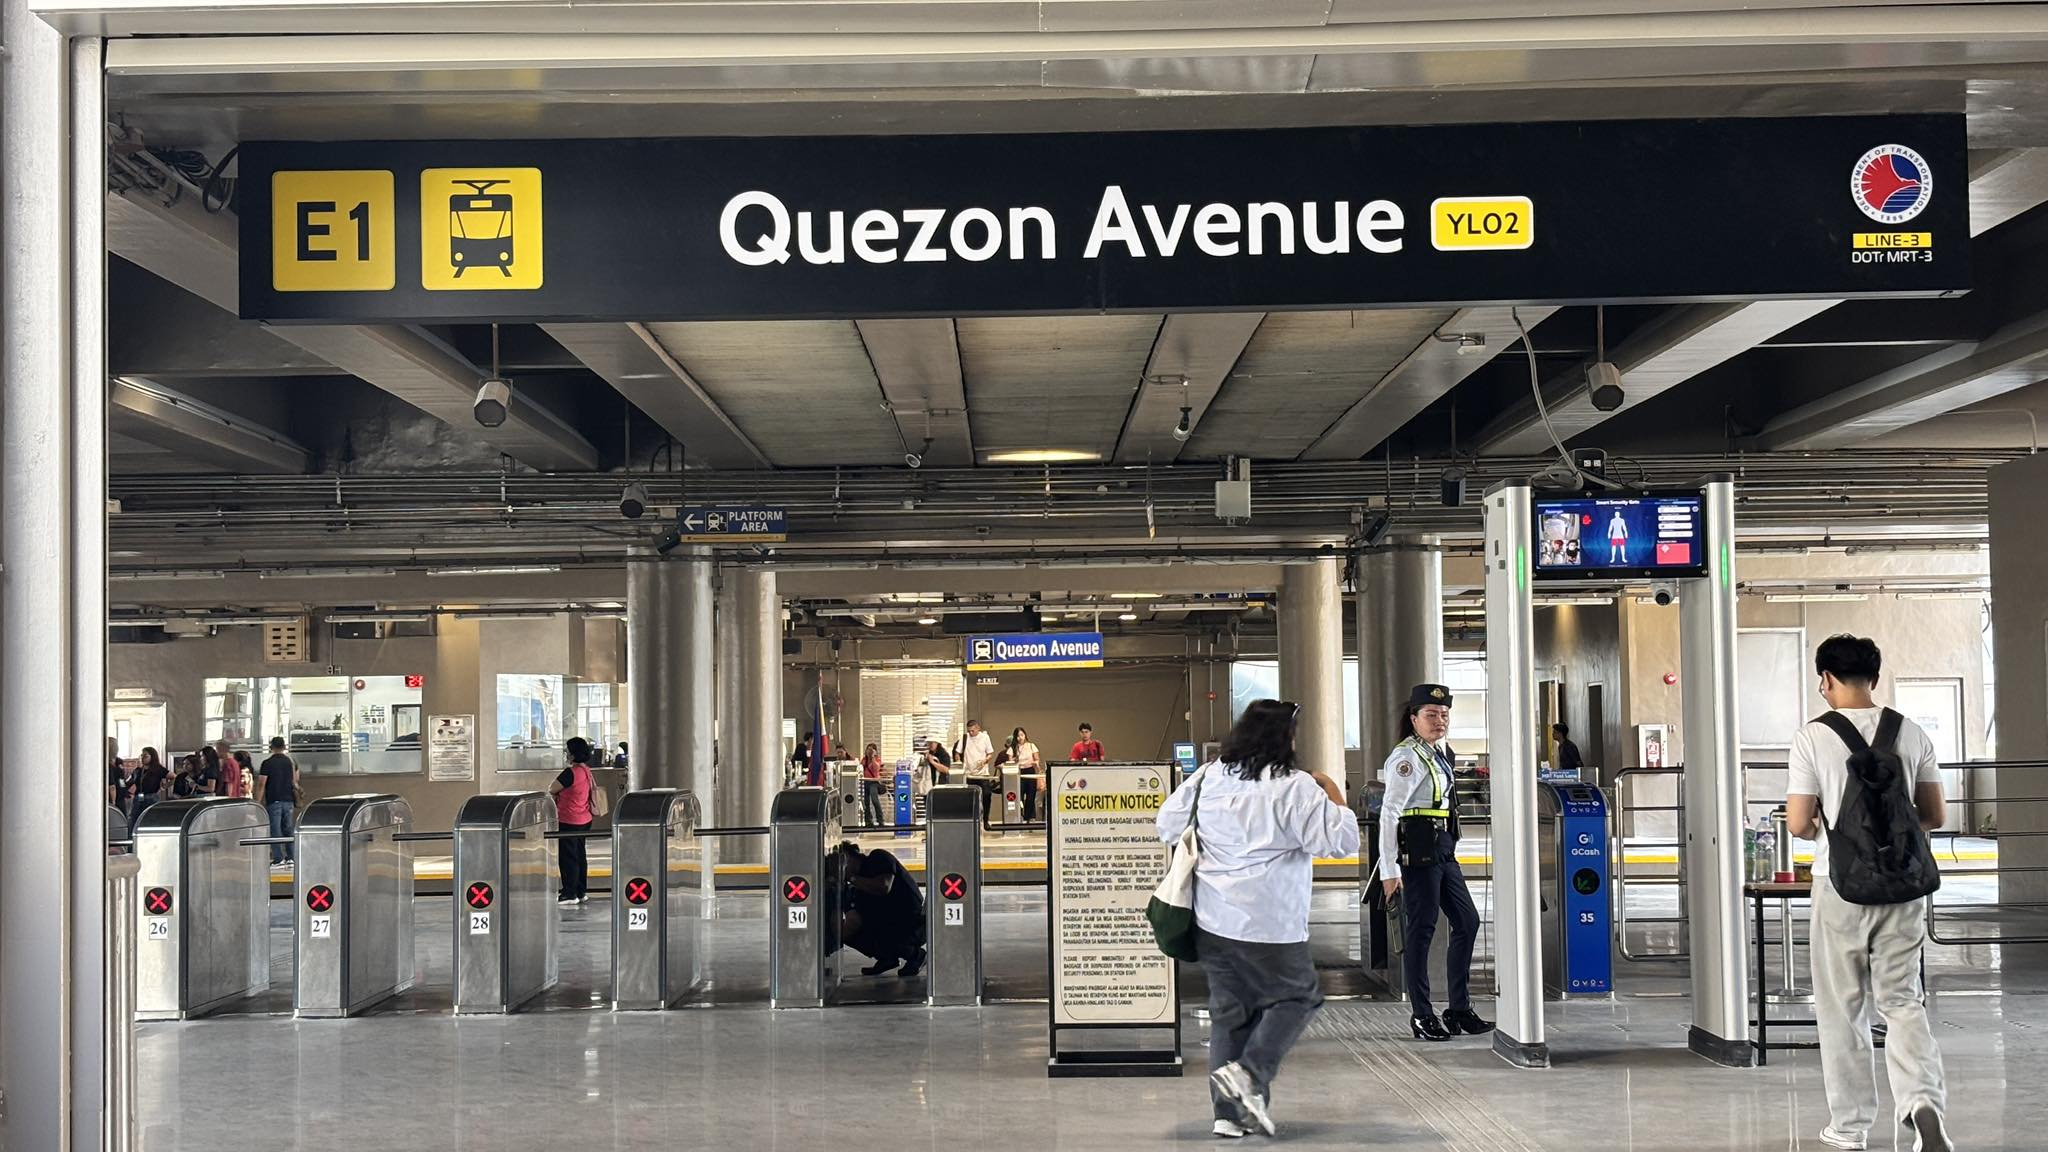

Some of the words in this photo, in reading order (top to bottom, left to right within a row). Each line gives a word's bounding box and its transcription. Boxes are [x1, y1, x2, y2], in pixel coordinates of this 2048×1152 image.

[1854, 154, 1872, 212] DEPARTMENT
[1891, 148, 1930, 212] TRANSPORTATION
[719, 190, 1056, 266] Quezon
[1082, 184, 1405, 259] Avenue
[297, 202, 370, 262] E1
[1866, 234, 1919, 246] LINE-3
[1852, 251, 1884, 263] DOTr
[1887, 250, 1932, 262] MRT-3
[729, 511, 782, 520] PLATFORM
[741, 522, 768, 531] AREA
[996, 642, 1046, 660] Quezon
[1050, 640, 1099, 656] Avenue
[1065, 796, 1116, 809] SECURITY
[1120, 795, 1159, 809] NOTICE
[630, 913, 646, 925] 29
[790, 912, 806, 924] 30
[946, 908, 960, 920] 31
[1580, 913, 1594, 922] 35
[150, 922, 167, 935] 26
[313, 920, 329, 932] 27
[472, 917, 488, 929] 28
